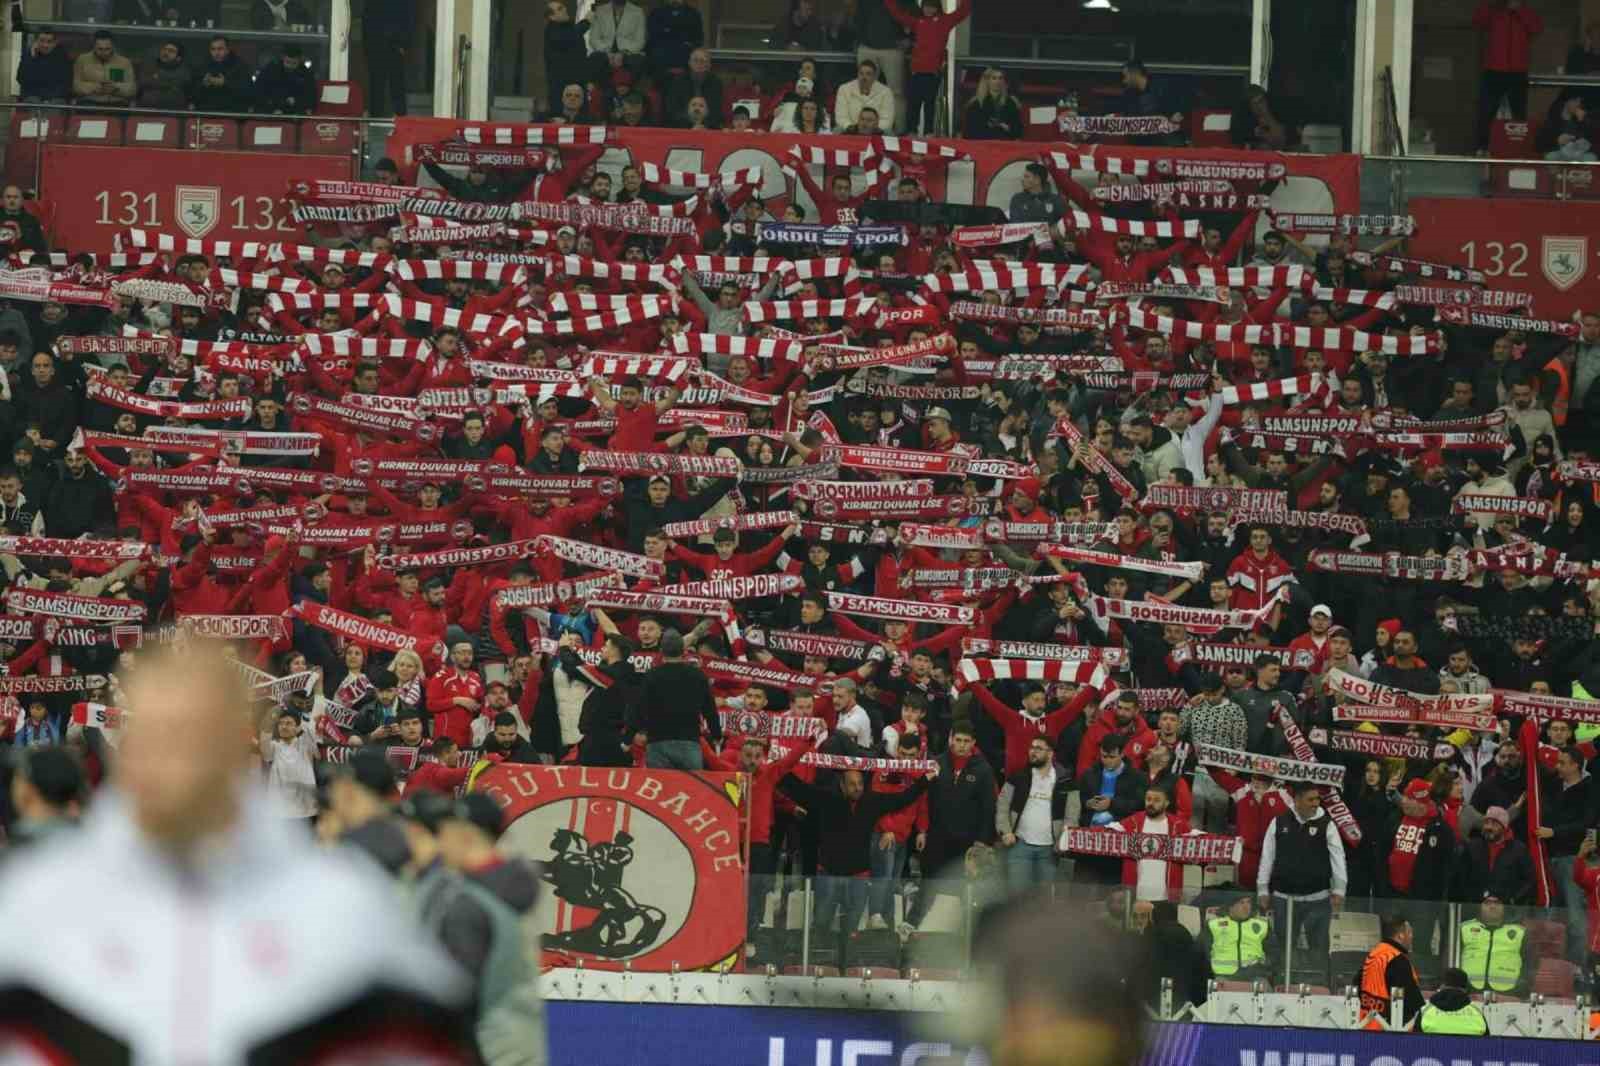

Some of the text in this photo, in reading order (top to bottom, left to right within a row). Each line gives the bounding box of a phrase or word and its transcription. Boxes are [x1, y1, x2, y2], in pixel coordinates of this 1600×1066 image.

[1084, 117, 1160, 133] SAMSUNSPOR
[1176, 164, 1265, 179] SAMSUNSPOR
[95, 190, 162, 226] 131
[230, 195, 297, 232] 132
[409, 224, 489, 241] SAMSUNSPOR
[762, 229, 900, 247] ORDU SPOR
[1460, 240, 1529, 278] 132
[1471, 312, 1552, 332] SAMSUNSPOR
[1084, 372, 1118, 390] KING
[868, 383, 961, 399] SAMSUNSPOR
[316, 400, 360, 419] KIRMIZI
[355, 409, 391, 427] DUVAR
[1264, 417, 1358, 433] SAMSUNSPOR
[378, 460, 419, 472] KIRMIZI
[420, 461, 456, 473] DUVAR
[130, 472, 172, 484] KIRMIZI
[173, 474, 208, 486] DUVAR
[491, 478, 532, 489] KIRMIZI
[533, 478, 569, 489] DUVAR
[843, 500, 884, 510] KIRMIZI
[884, 500, 920, 510] DUVAR
[310, 527, 347, 538] DUVAR
[400, 544, 520, 567] SAMSUNSPOR
[664, 574, 778, 599] SAMSUNSPOR
[26, 595, 128, 618] SAMSUNSPOR
[847, 599, 951, 619] SAMSUNSPOR
[57, 628, 96, 646] KING
[318, 608, 417, 651] SAMSUNSPOR
[769, 634, 865, 660] SAMSUNSPOR
[1000, 643, 1090, 661] SAMSUNSPOR
[707, 660, 752, 677] KIRMIZI
[751, 667, 791, 681] DUVAR
[0, 678, 84, 694] MSUNSPOR
[1331, 734, 1430, 759] SAMSUNSPOR
[1200, 747, 1251, 770] FORZA
